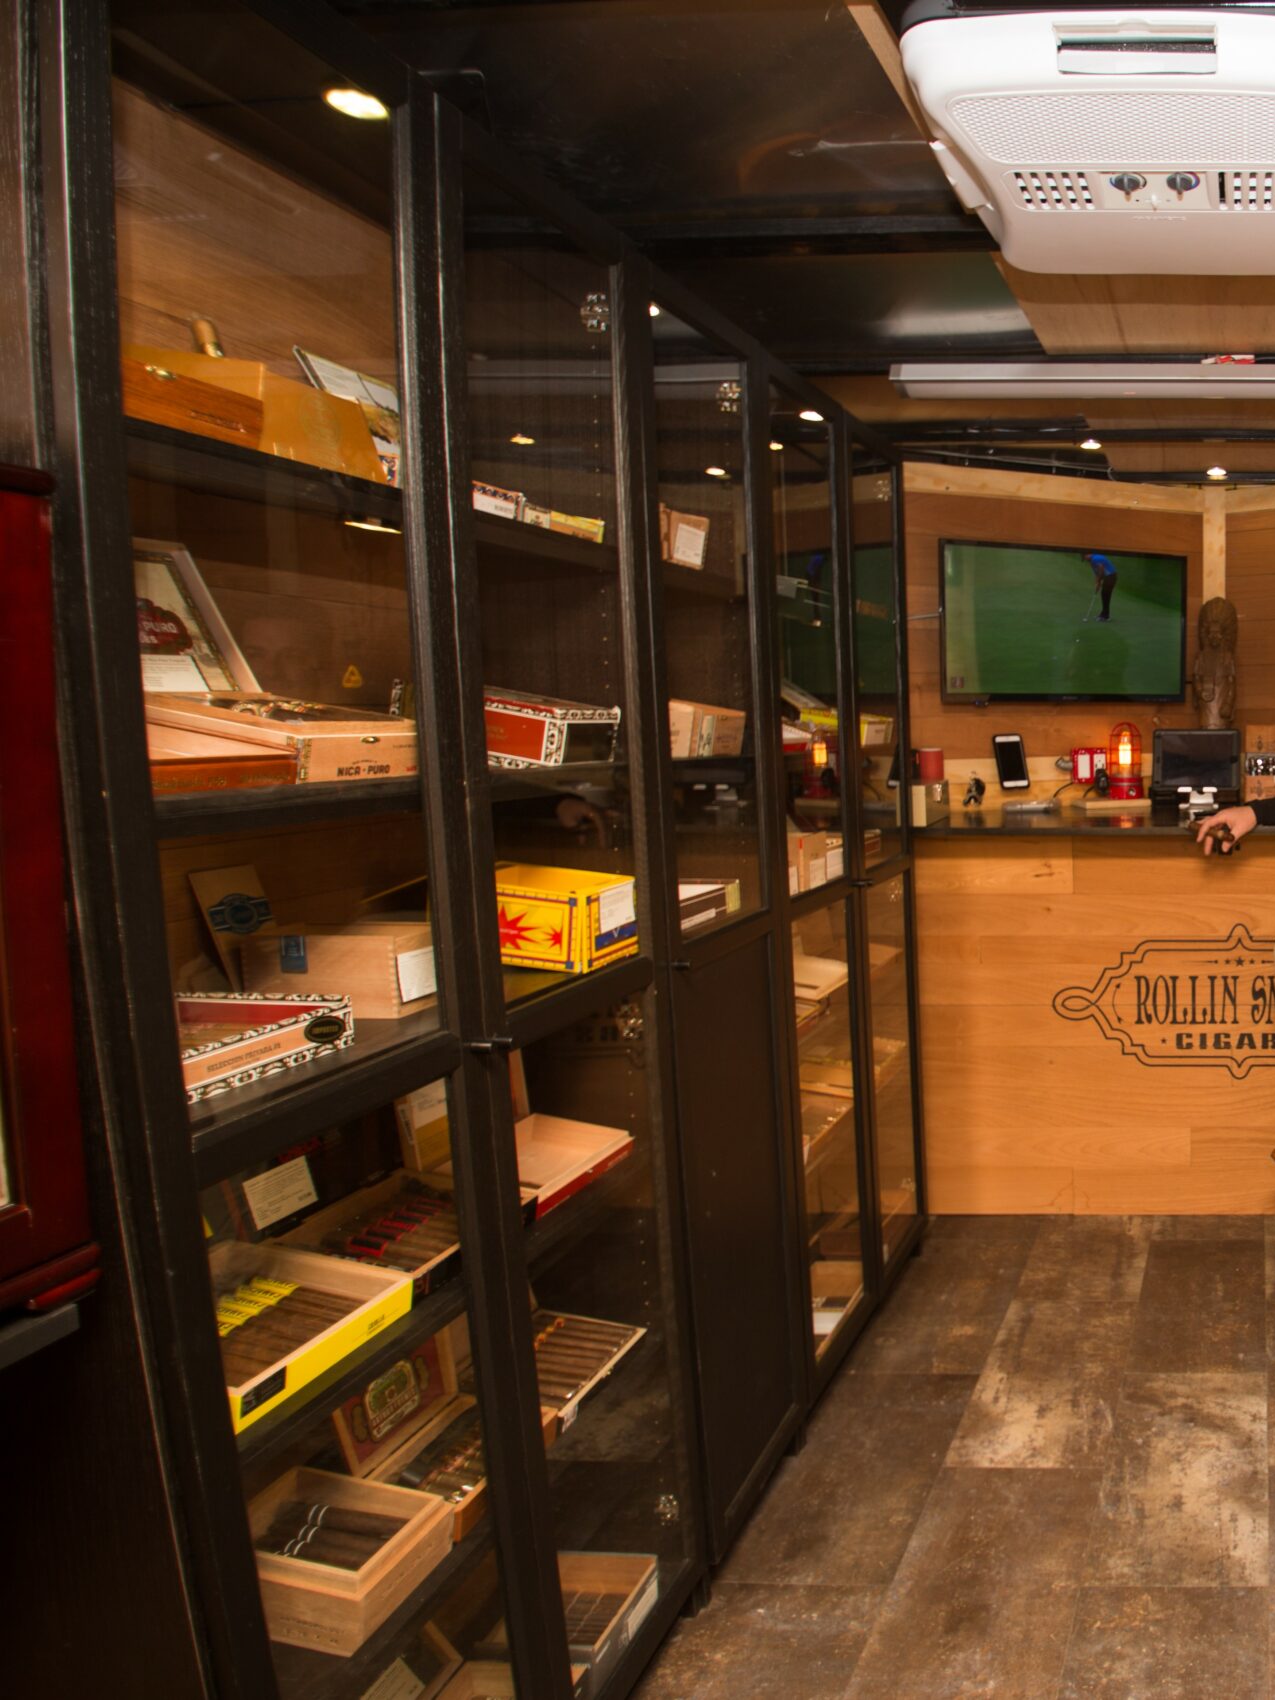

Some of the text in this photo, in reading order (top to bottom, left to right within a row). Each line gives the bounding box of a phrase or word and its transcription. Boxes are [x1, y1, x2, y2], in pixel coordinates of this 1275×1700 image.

[336, 764, 391, 777] NICA PURO
[1134, 975, 1240, 1024] ROLLIN
